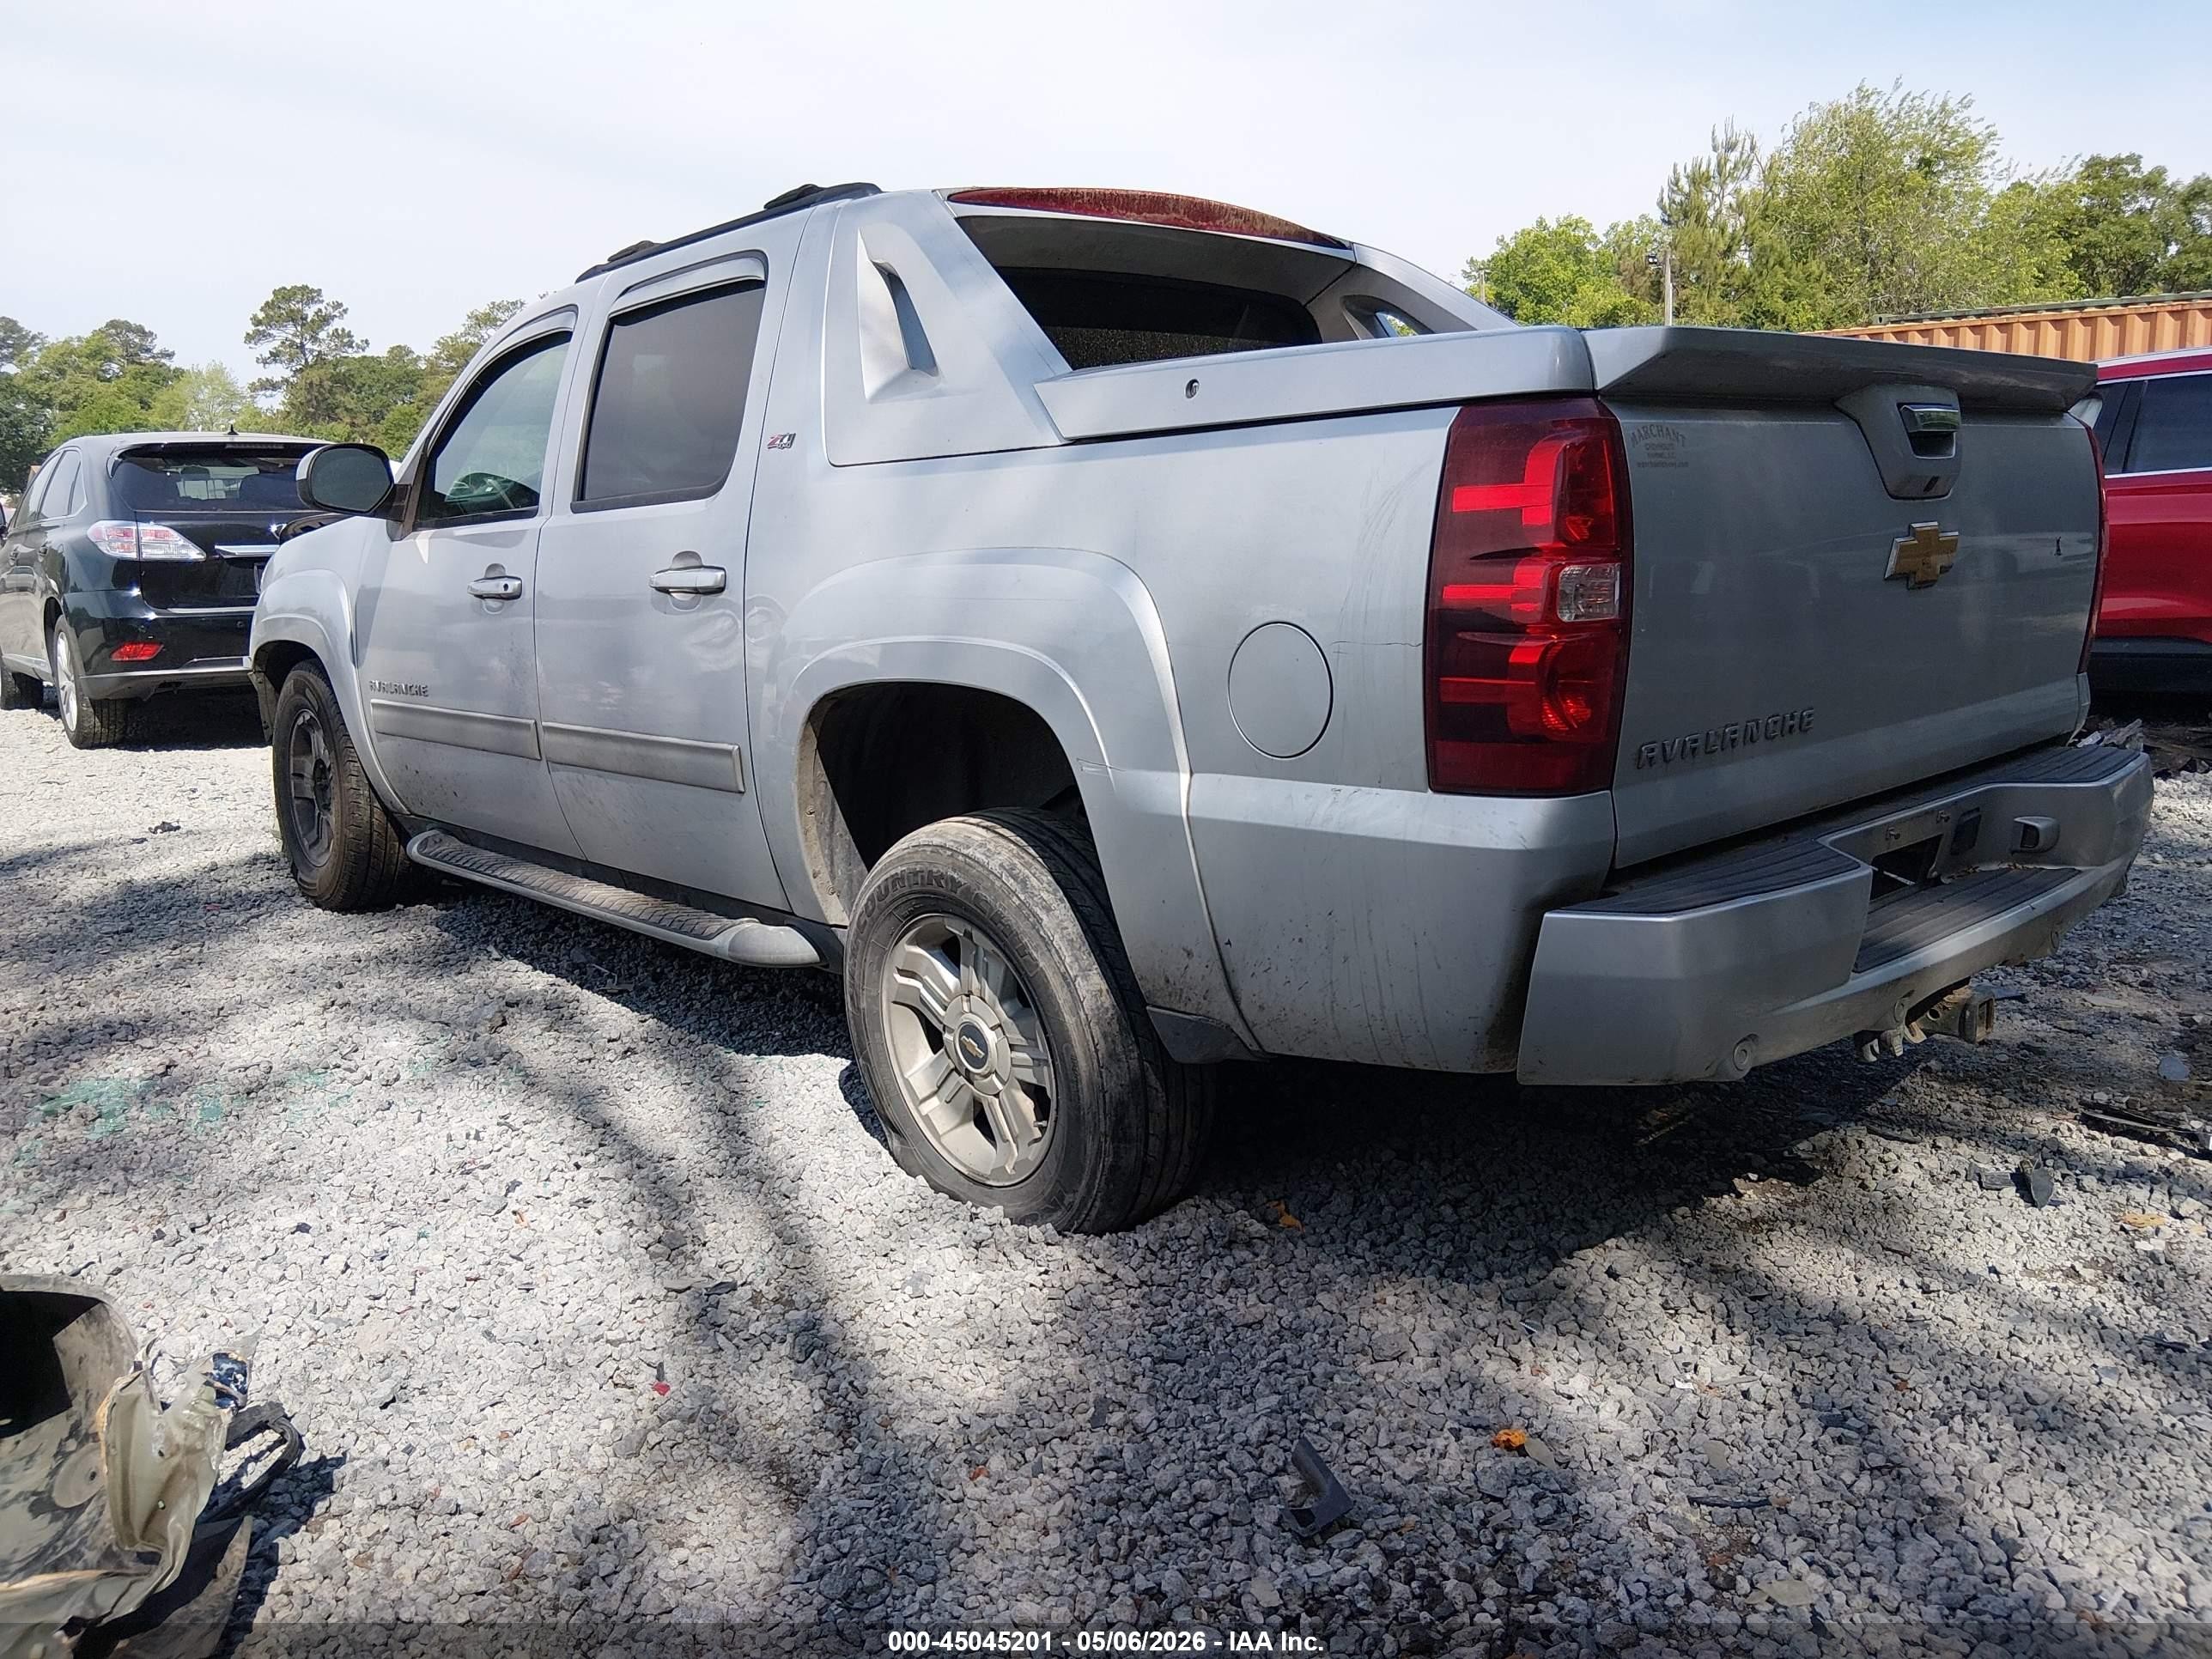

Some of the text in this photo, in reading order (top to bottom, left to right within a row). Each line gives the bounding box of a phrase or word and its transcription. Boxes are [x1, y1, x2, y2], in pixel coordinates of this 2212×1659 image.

[767, 433, 797, 450] Z71
[1631, 424, 1686, 448] MARCHANT
[368, 679, 428, 697] AVALANCHE
[1636, 707, 1815, 770] AVALANCHE
[856, 867, 968, 935] COUNTRY
